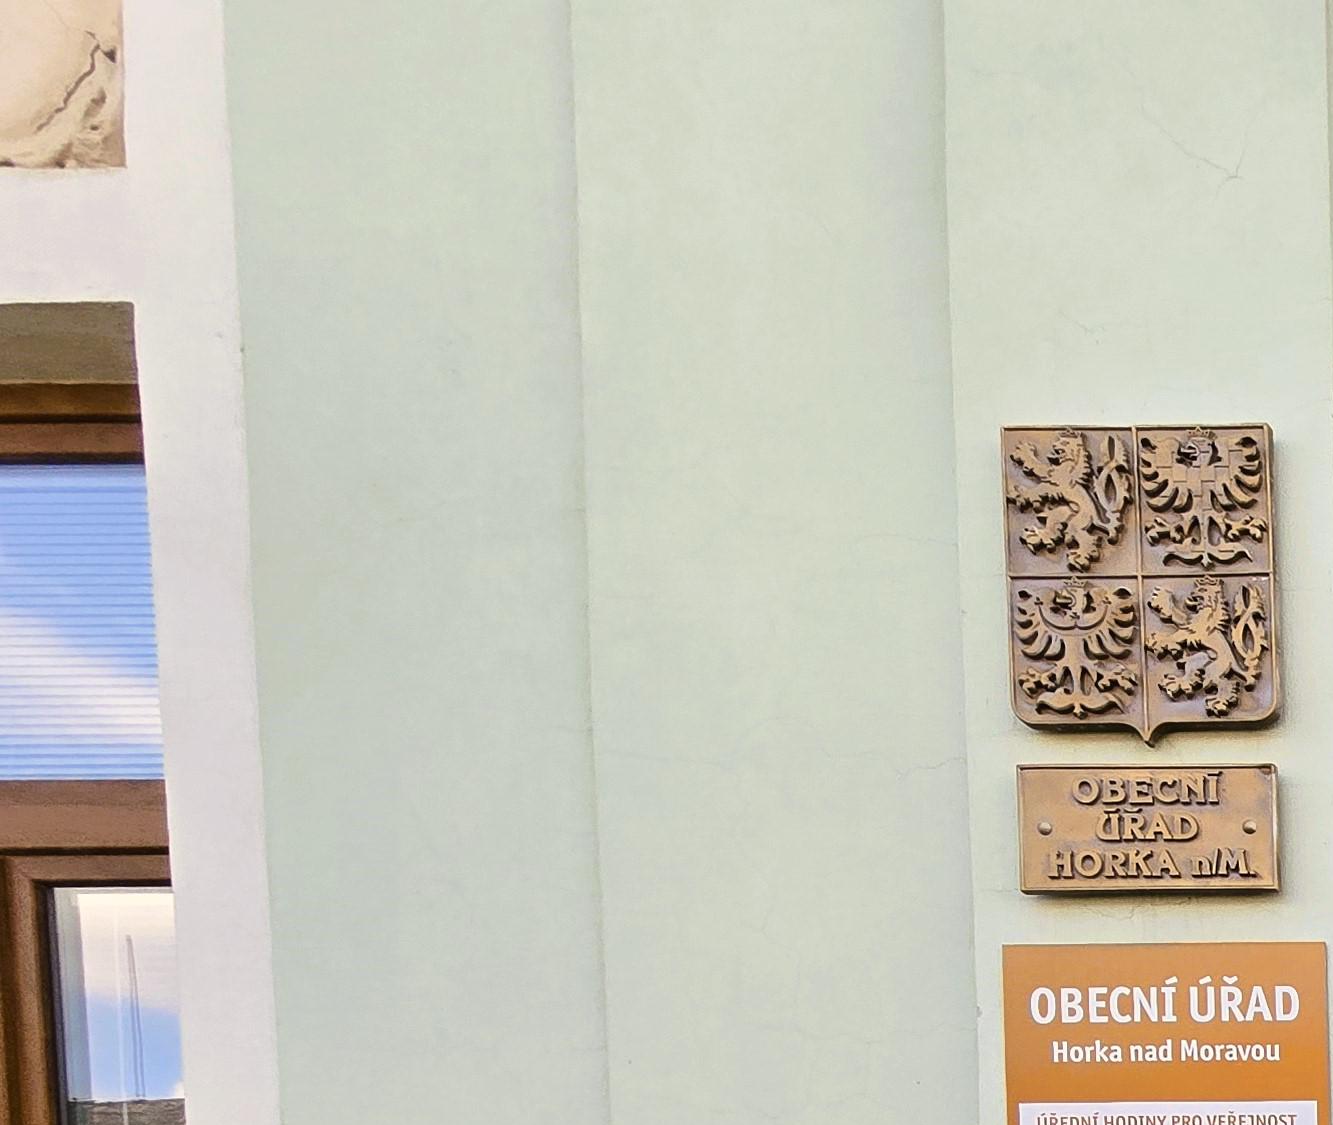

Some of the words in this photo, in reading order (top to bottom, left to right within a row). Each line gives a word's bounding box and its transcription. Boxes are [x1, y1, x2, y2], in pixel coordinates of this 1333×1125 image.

[1072, 771, 1222, 805] OBECNÍ
[1096, 808, 1199, 841] ÚŘAD
[1049, 849, 1180, 878] HORKA
[1030, 976, 1179, 1024] OBECNÍ
[1189, 975, 1300, 1022] ÚŘAD
[1052, 1040, 1122, 1063] Horka
[1130, 1039, 1172, 1062] nad
[1181, 1039, 1280, 1062] Moravou
